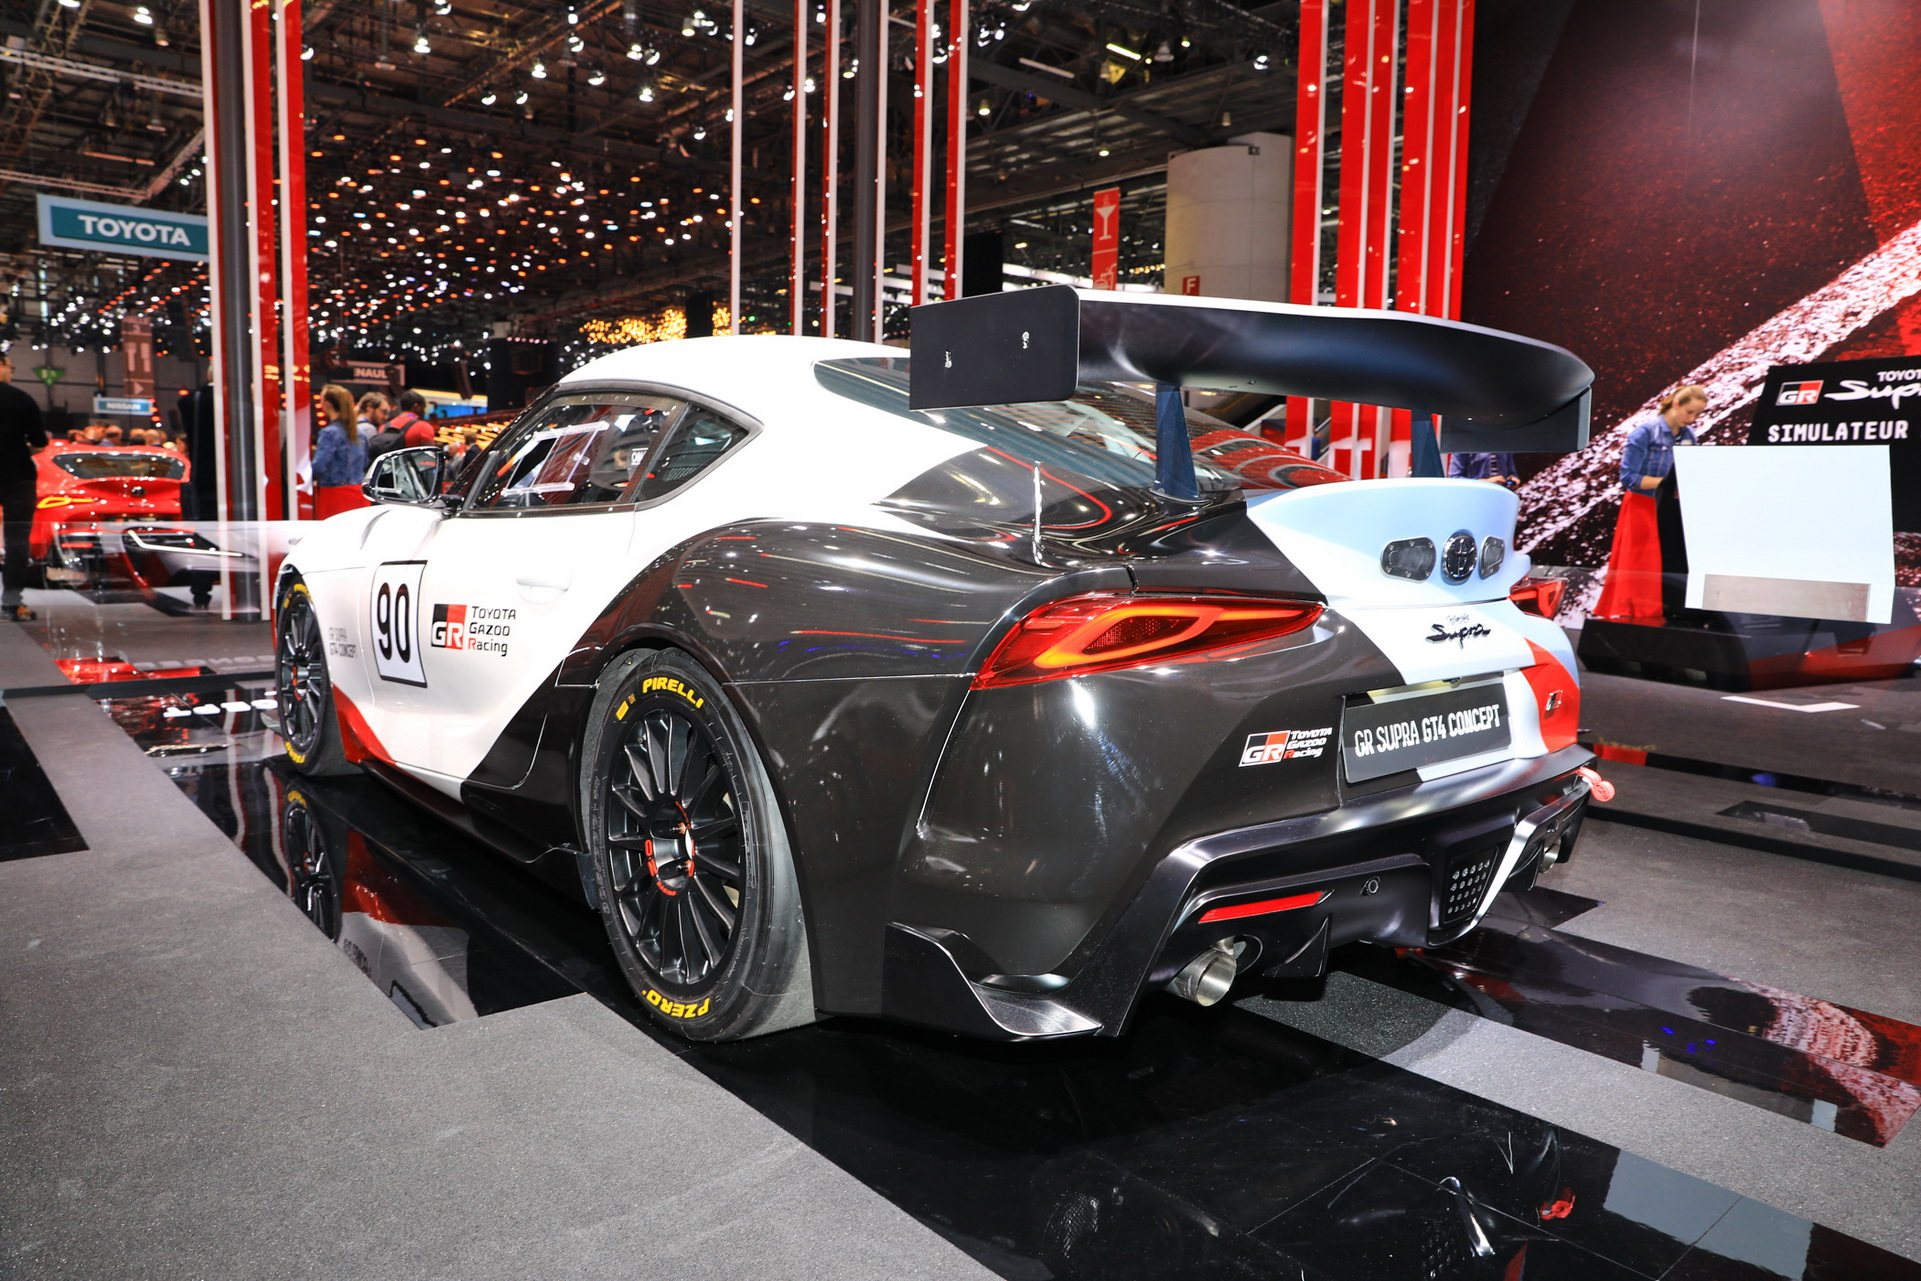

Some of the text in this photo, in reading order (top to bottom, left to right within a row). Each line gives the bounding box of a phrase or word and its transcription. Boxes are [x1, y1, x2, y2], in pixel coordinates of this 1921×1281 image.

[77, 214, 192, 247] TOYOTA
[1777, 379, 1921, 410] GR Sup
[1767, 420, 1909, 443] SIMULATEUR
[376, 582, 411, 664] 90
[471, 605, 517, 620] TOYOTA
[431, 621, 464, 649] GR
[468, 622, 511, 637] GAZOO
[1425, 623, 1492, 650] Supra
[467, 637, 508, 657] Racing
[642, 677, 705, 709] PIRELLI
[1290, 727, 1333, 739] TOYOTA
[1354, 703, 1501, 758] GR SUPRA GT4 CONCEPT
[1243, 744, 1281, 764] GR
[1284, 747, 1324, 760] Racing
[1287, 737, 1328, 750] GAZOO
